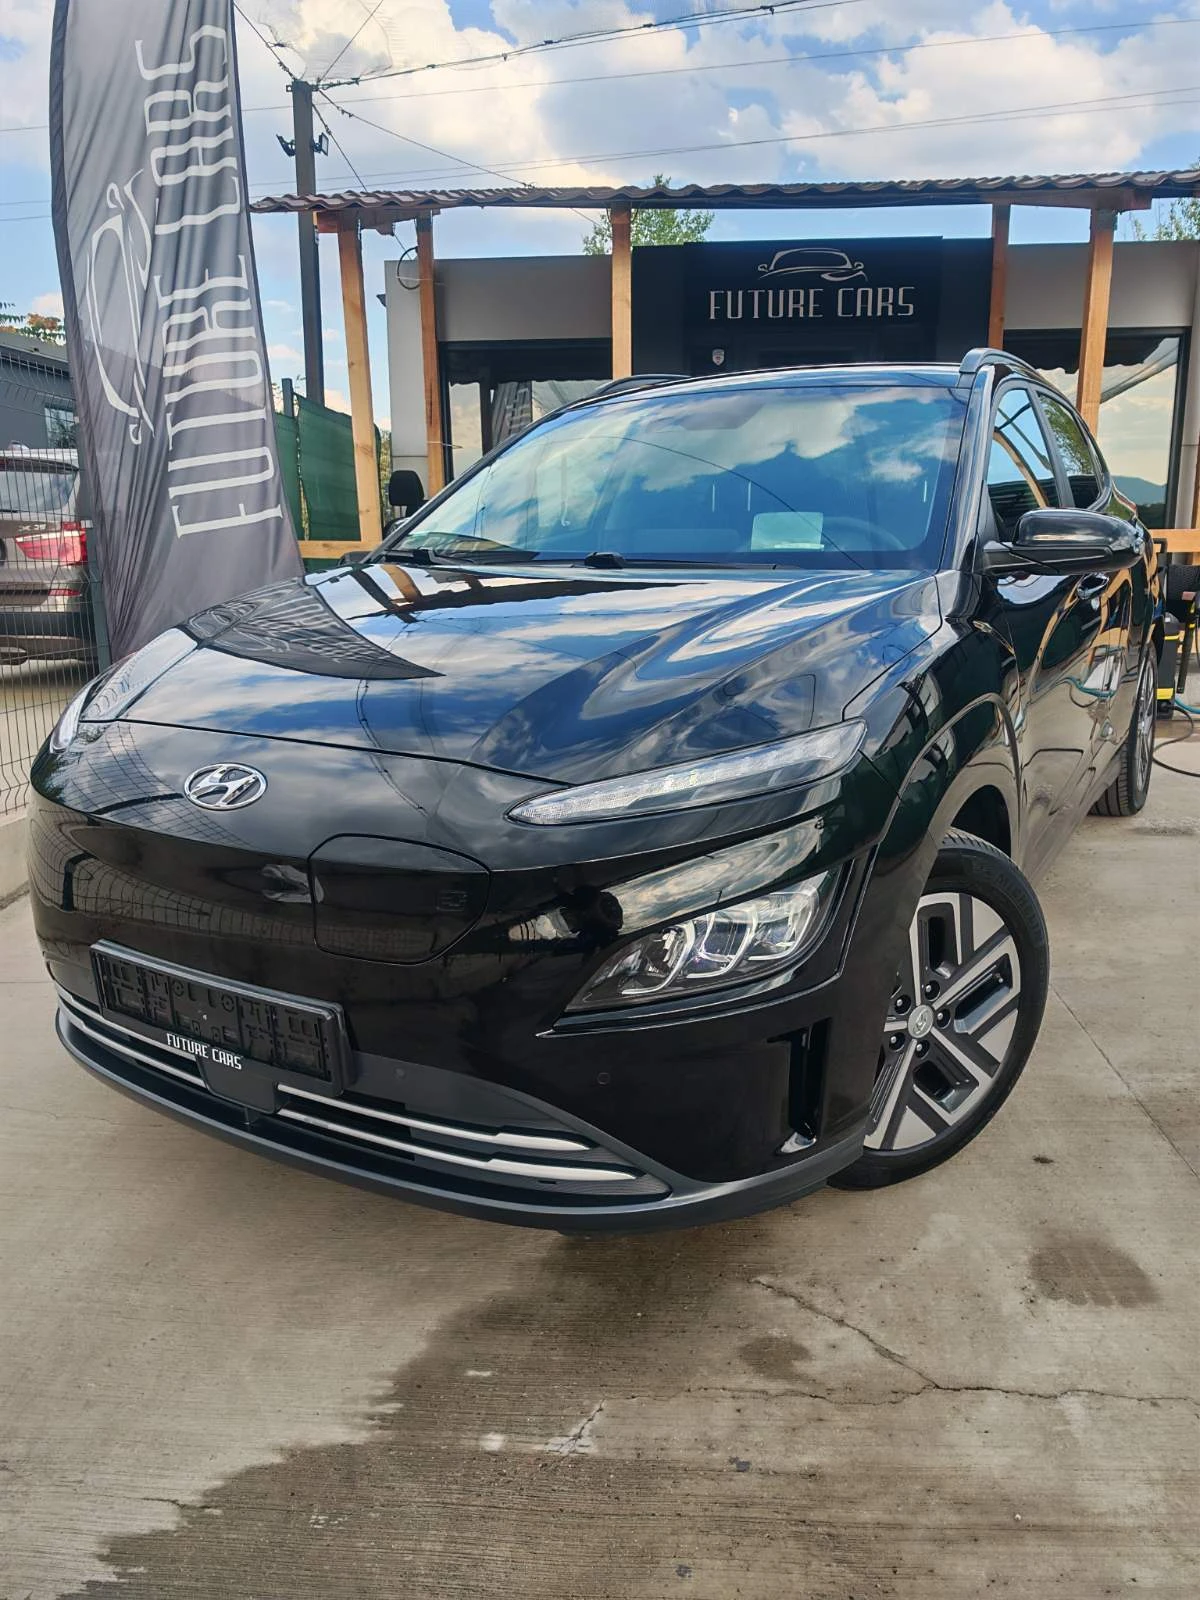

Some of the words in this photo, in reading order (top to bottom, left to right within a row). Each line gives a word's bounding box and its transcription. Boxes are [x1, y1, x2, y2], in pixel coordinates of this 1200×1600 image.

[135, 24, 240, 235] CARS
[709, 288, 824, 320] FUTURE
[837, 286, 916, 317] CARS
[154, 254, 283, 538] FUTURE
[166, 1032, 210, 1059] FUTURE
[211, 1048, 243, 1070] CARS
